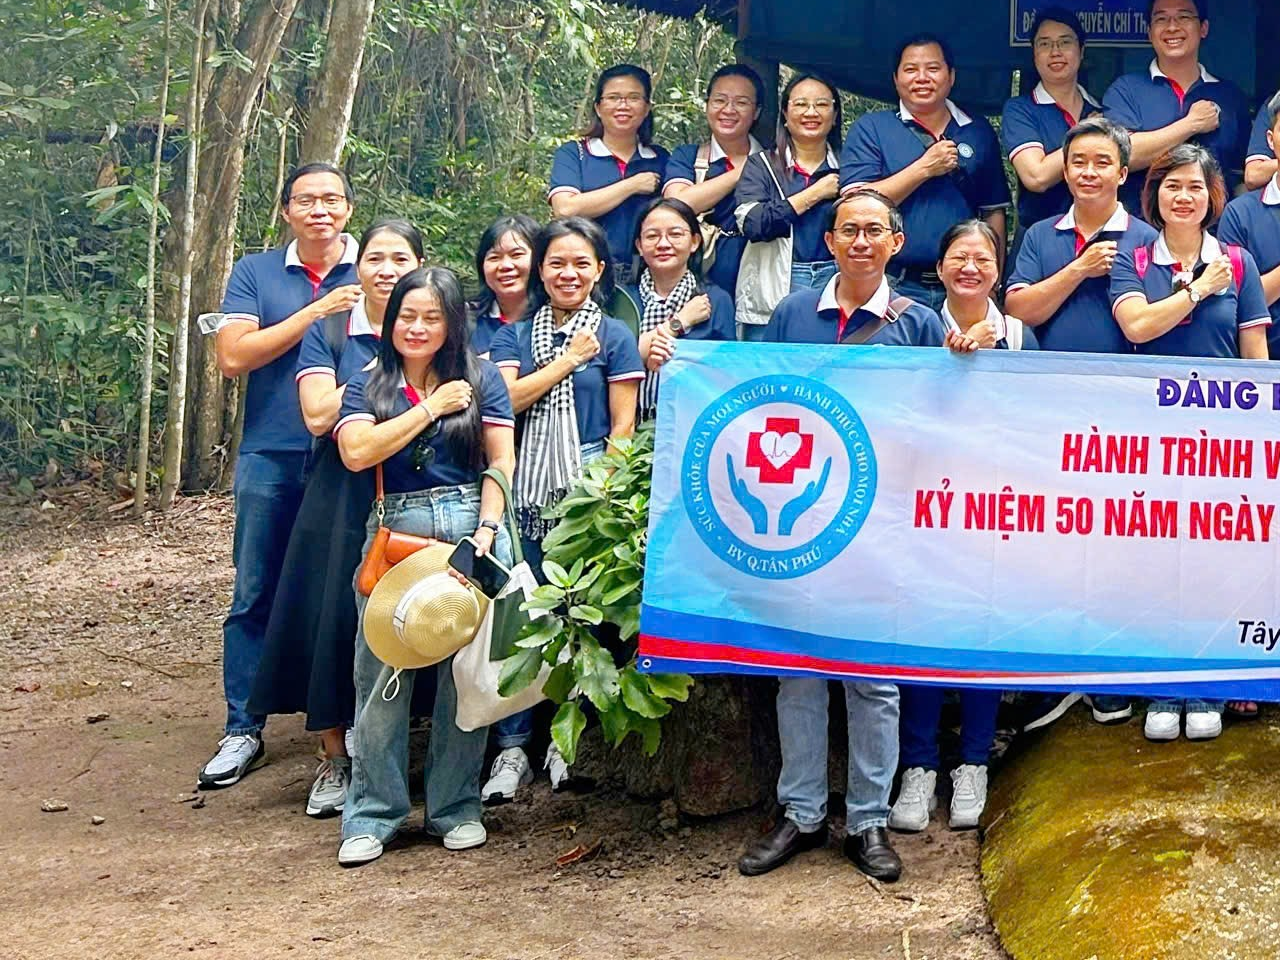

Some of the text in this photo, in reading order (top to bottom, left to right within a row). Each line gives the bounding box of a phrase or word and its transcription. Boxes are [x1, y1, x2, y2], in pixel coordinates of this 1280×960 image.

[1076, 2, 1111, 33] GUYỄN
[1113, 8, 1131, 33] CHÍ
[1157, 372, 1259, 410] ĐẢNG
[693, 431, 711, 458] CỦA
[706, 402, 733, 428] MỌI
[731, 383, 775, 408] NGƯỜI
[829, 406, 859, 441] PHÚC
[853, 441, 869, 473] CHO
[1061, 426, 1149, 475] HÀNH
[1160, 430, 1253, 478] TRÌNH
[853, 475, 868, 504] MỌI
[836, 508, 860, 536] NHÀ
[914, 478, 954, 529] KỶ
[964, 486, 1045, 541] NIỆM
[1056, 496, 1093, 535] 50
[1104, 492, 1178, 539] NĂM
[1189, 494, 1274, 542] NGÀY
[726, 543, 822, 573] BV Q.TÂN PHÚ
